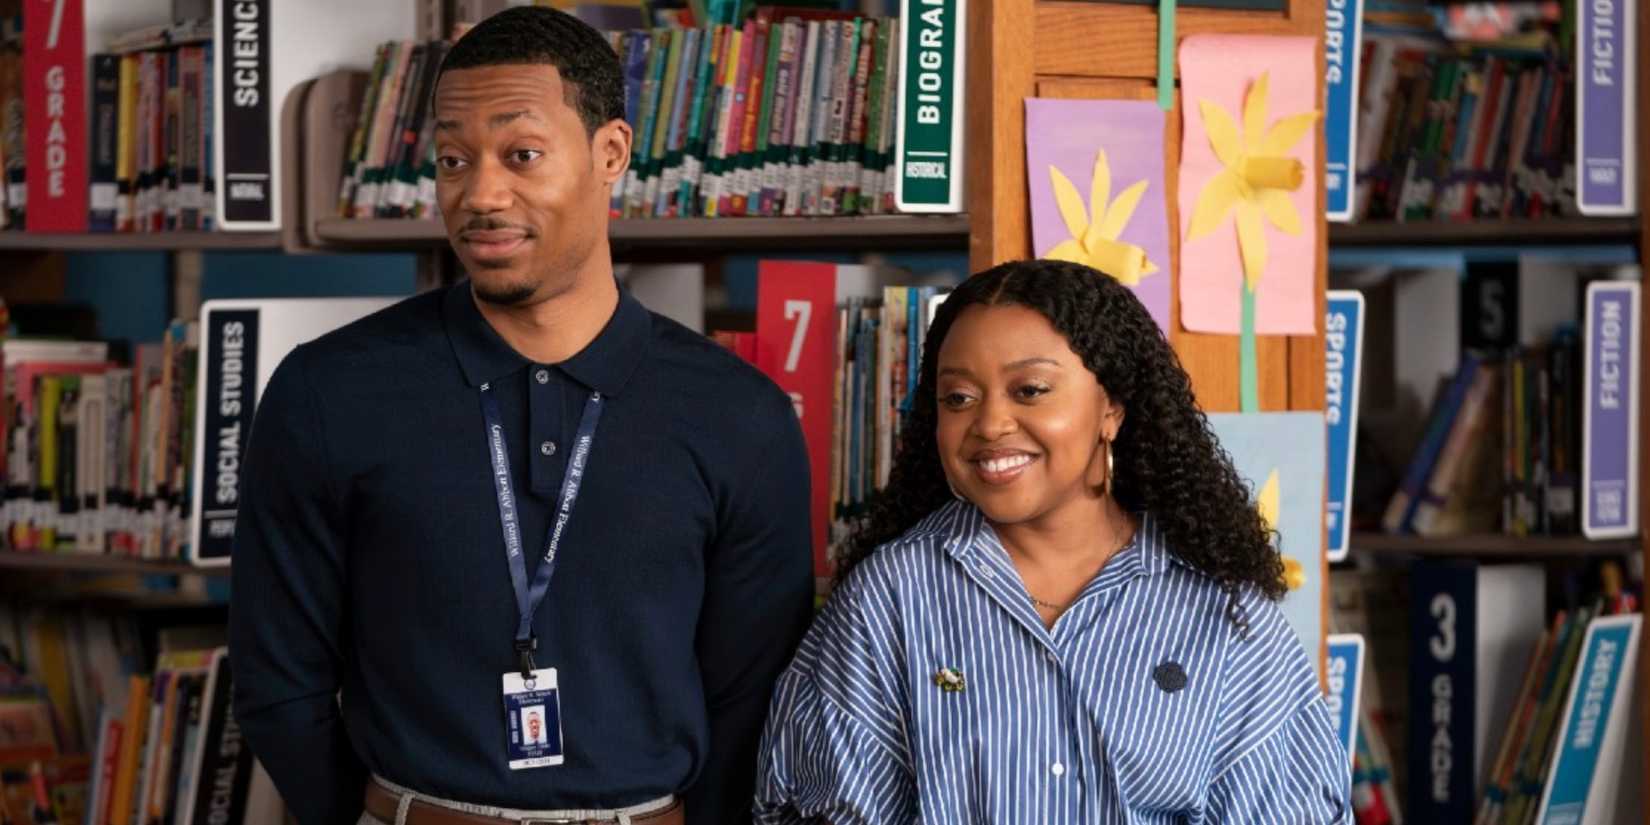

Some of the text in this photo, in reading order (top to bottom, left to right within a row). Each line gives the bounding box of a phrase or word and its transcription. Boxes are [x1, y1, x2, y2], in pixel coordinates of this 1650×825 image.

[233, 0, 259, 107] SCIENC
[917, 0, 944, 124] BIOGRA
[45, 66, 66, 197] GRADE
[221, 320, 245, 418] STUDIES
[784, 299, 812, 373] 7
[1325, 312, 1347, 425] SPORTS
[1600, 301, 1622, 409] FICTION
[216, 421, 241, 505] SOCIAL
[1430, 593, 1456, 662] 3
[1431, 674, 1453, 801] GRADE
[1573, 639, 1618, 750] HISTORY
